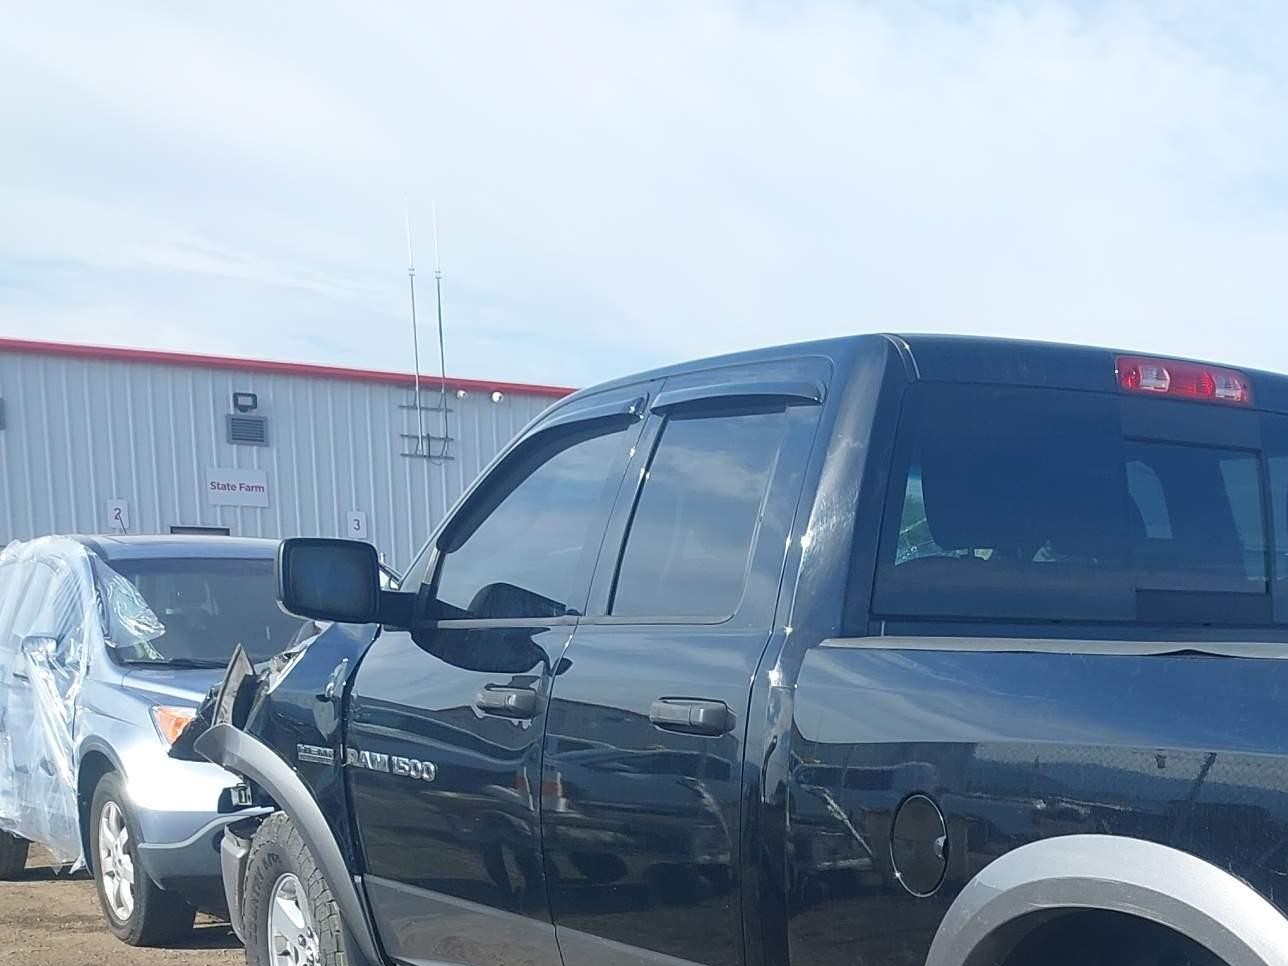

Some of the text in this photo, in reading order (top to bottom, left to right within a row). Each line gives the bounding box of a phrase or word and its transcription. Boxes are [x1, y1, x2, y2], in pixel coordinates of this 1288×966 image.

[210, 480, 265, 494] State Farm
[113, 507, 122, 521] 2
[352, 518, 361, 531] 3
[346, 747, 437, 782] RAM 1500
